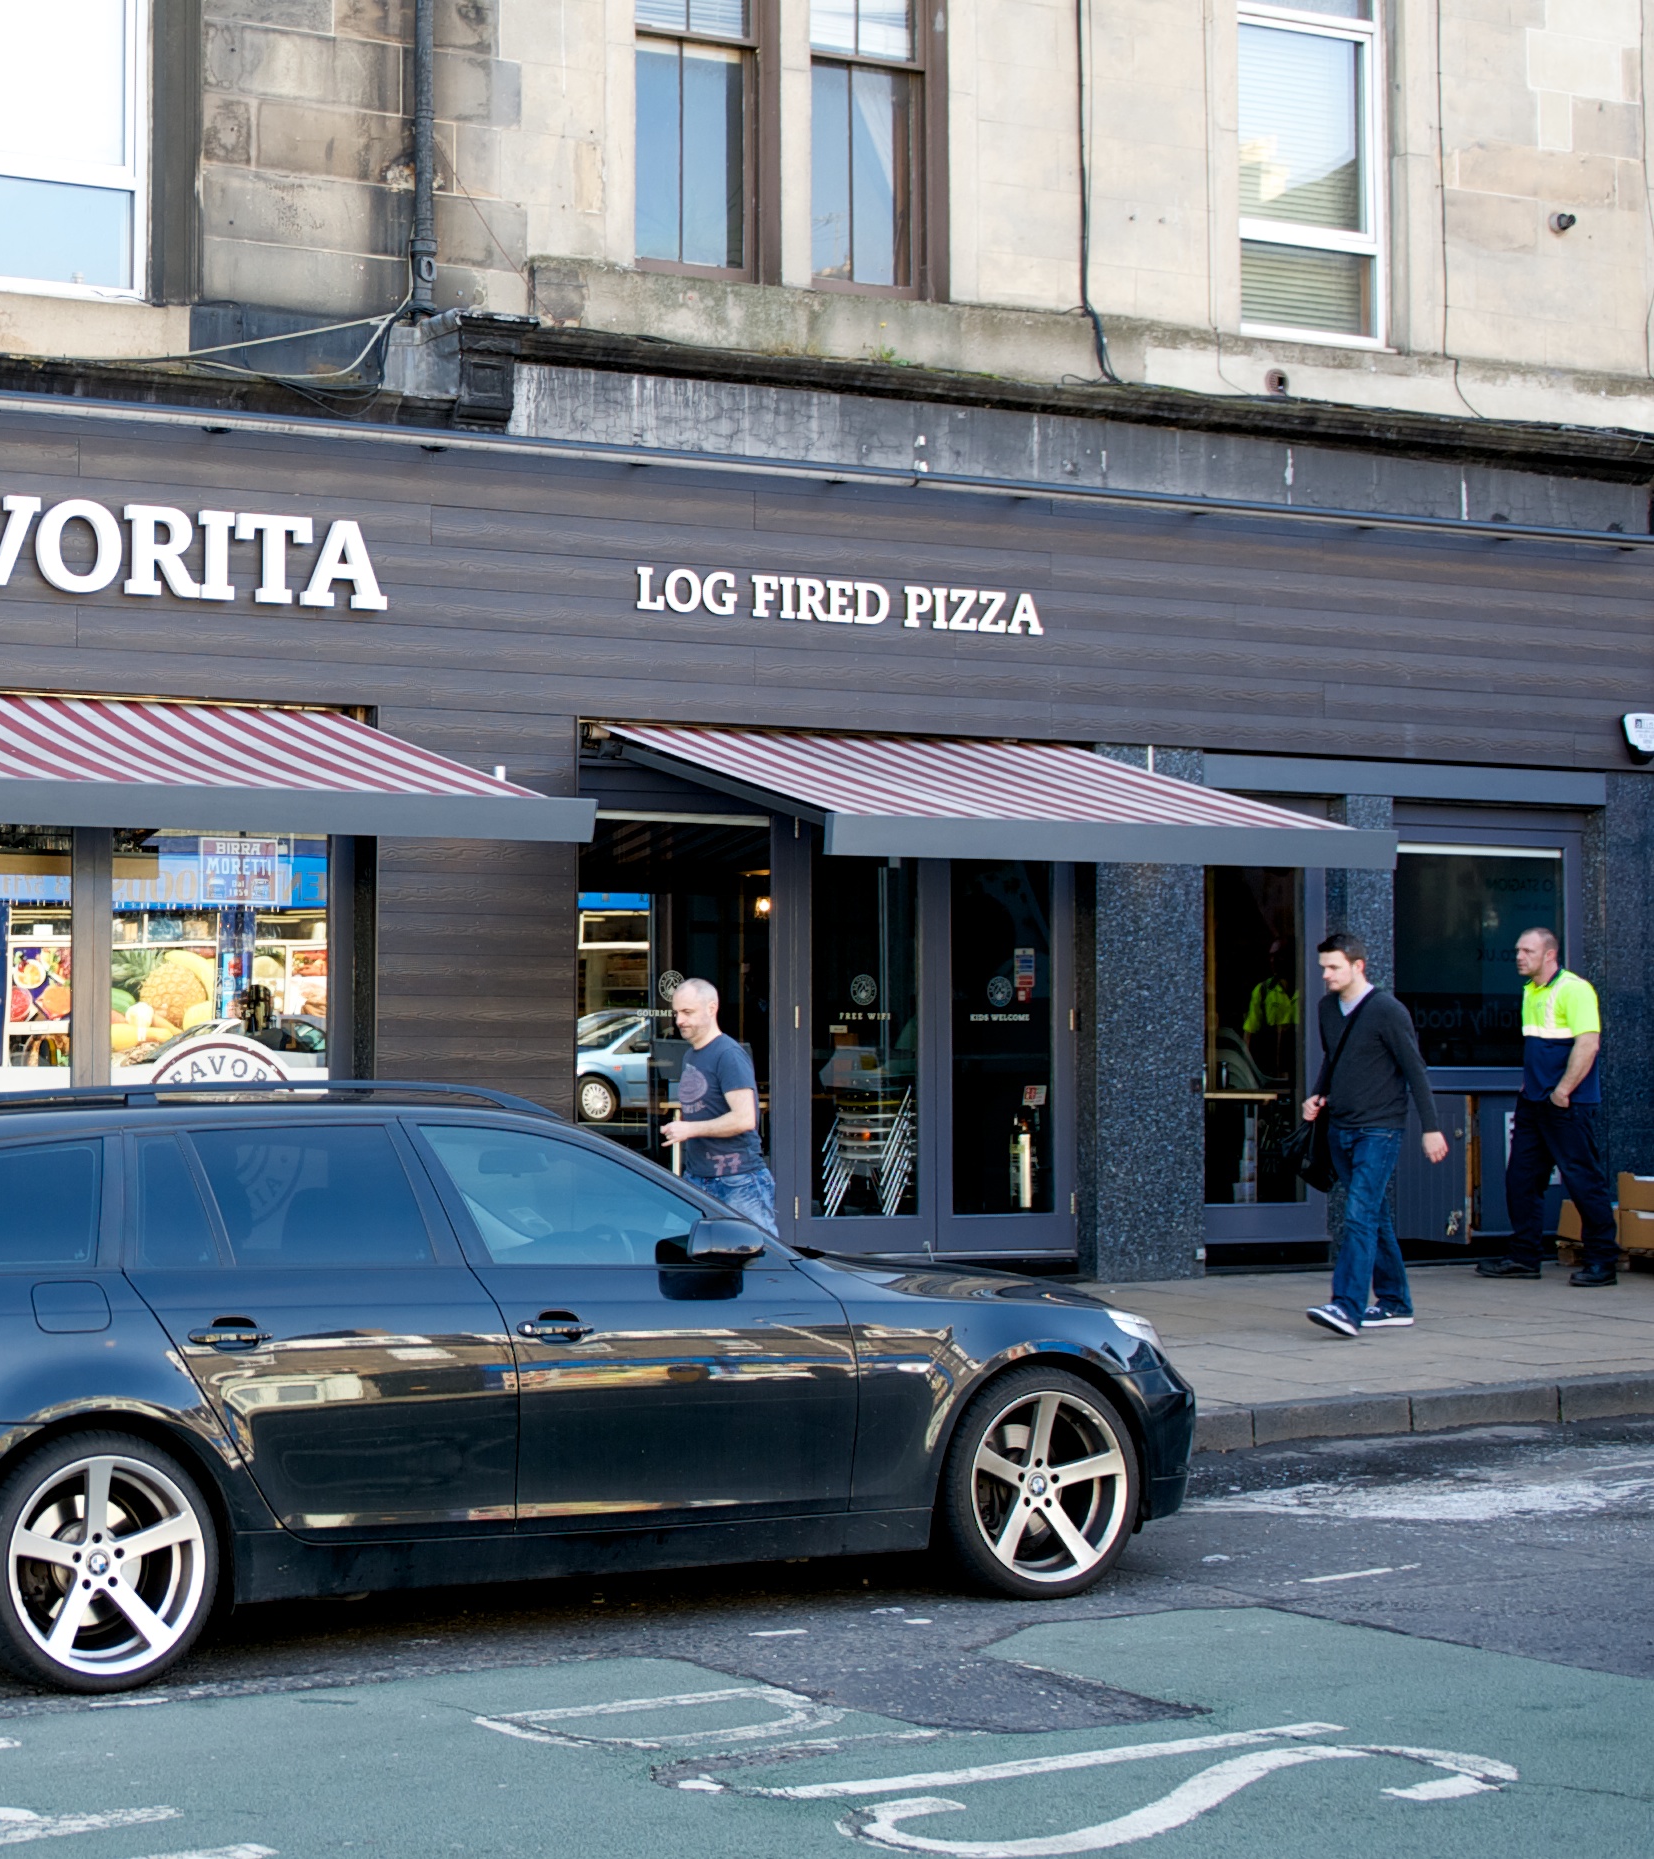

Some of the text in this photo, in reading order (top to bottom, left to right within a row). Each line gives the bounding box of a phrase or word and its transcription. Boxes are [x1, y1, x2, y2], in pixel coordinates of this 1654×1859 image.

[636, 566, 1044, 636] LOG FIRED PIZZA
[215, 842, 261, 855] BIRRA
[206, 857, 272, 876] MORETTI
[636, 1009, 676, 1018] GOURME
[839, 1012, 892, 1021] FREE WIFI
[970, 1013, 1031, 1022] KIDS WELCOME
